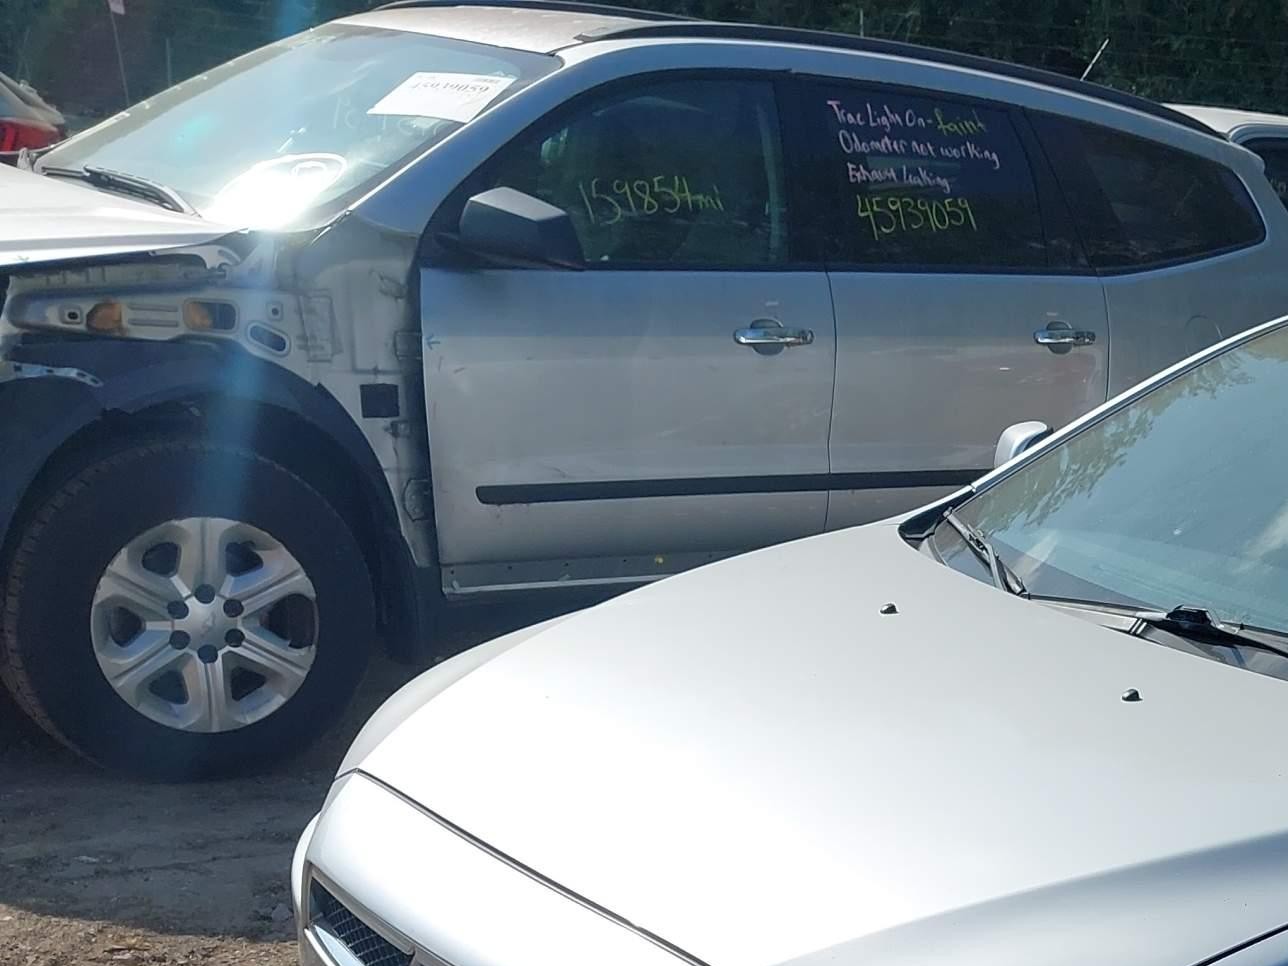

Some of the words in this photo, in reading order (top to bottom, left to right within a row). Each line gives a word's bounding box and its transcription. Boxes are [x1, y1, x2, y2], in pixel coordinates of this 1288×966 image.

[827, 100, 865, 125] Trac
[867, 103, 903, 132] Light
[856, 194, 977, 240] 45939059
